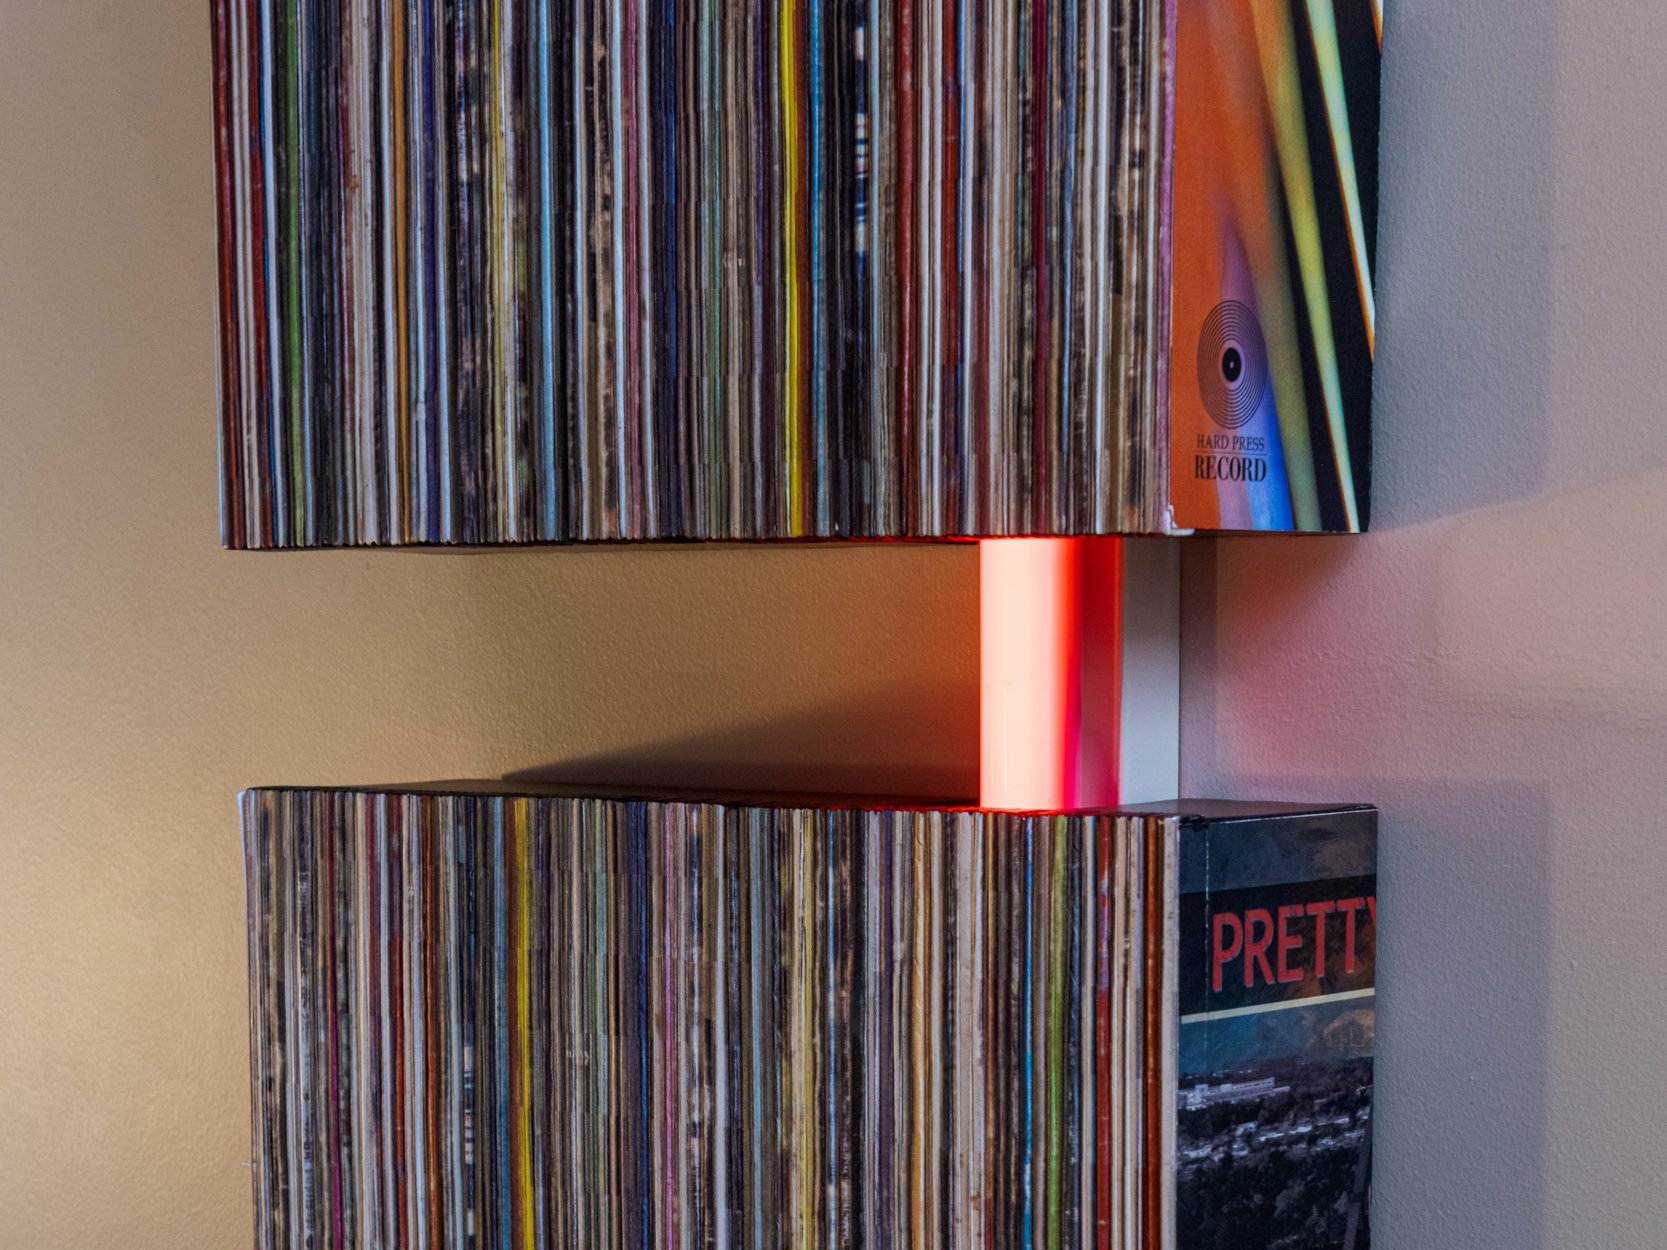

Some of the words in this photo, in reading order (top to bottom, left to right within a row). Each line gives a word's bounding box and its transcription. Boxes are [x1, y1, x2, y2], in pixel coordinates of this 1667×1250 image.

[1197, 434, 1229, 449] HARD
[1232, 435, 1265, 451] PRESS
[1194, 455, 1266, 482] RECORD
[1212, 896, 1376, 993] PRETT
